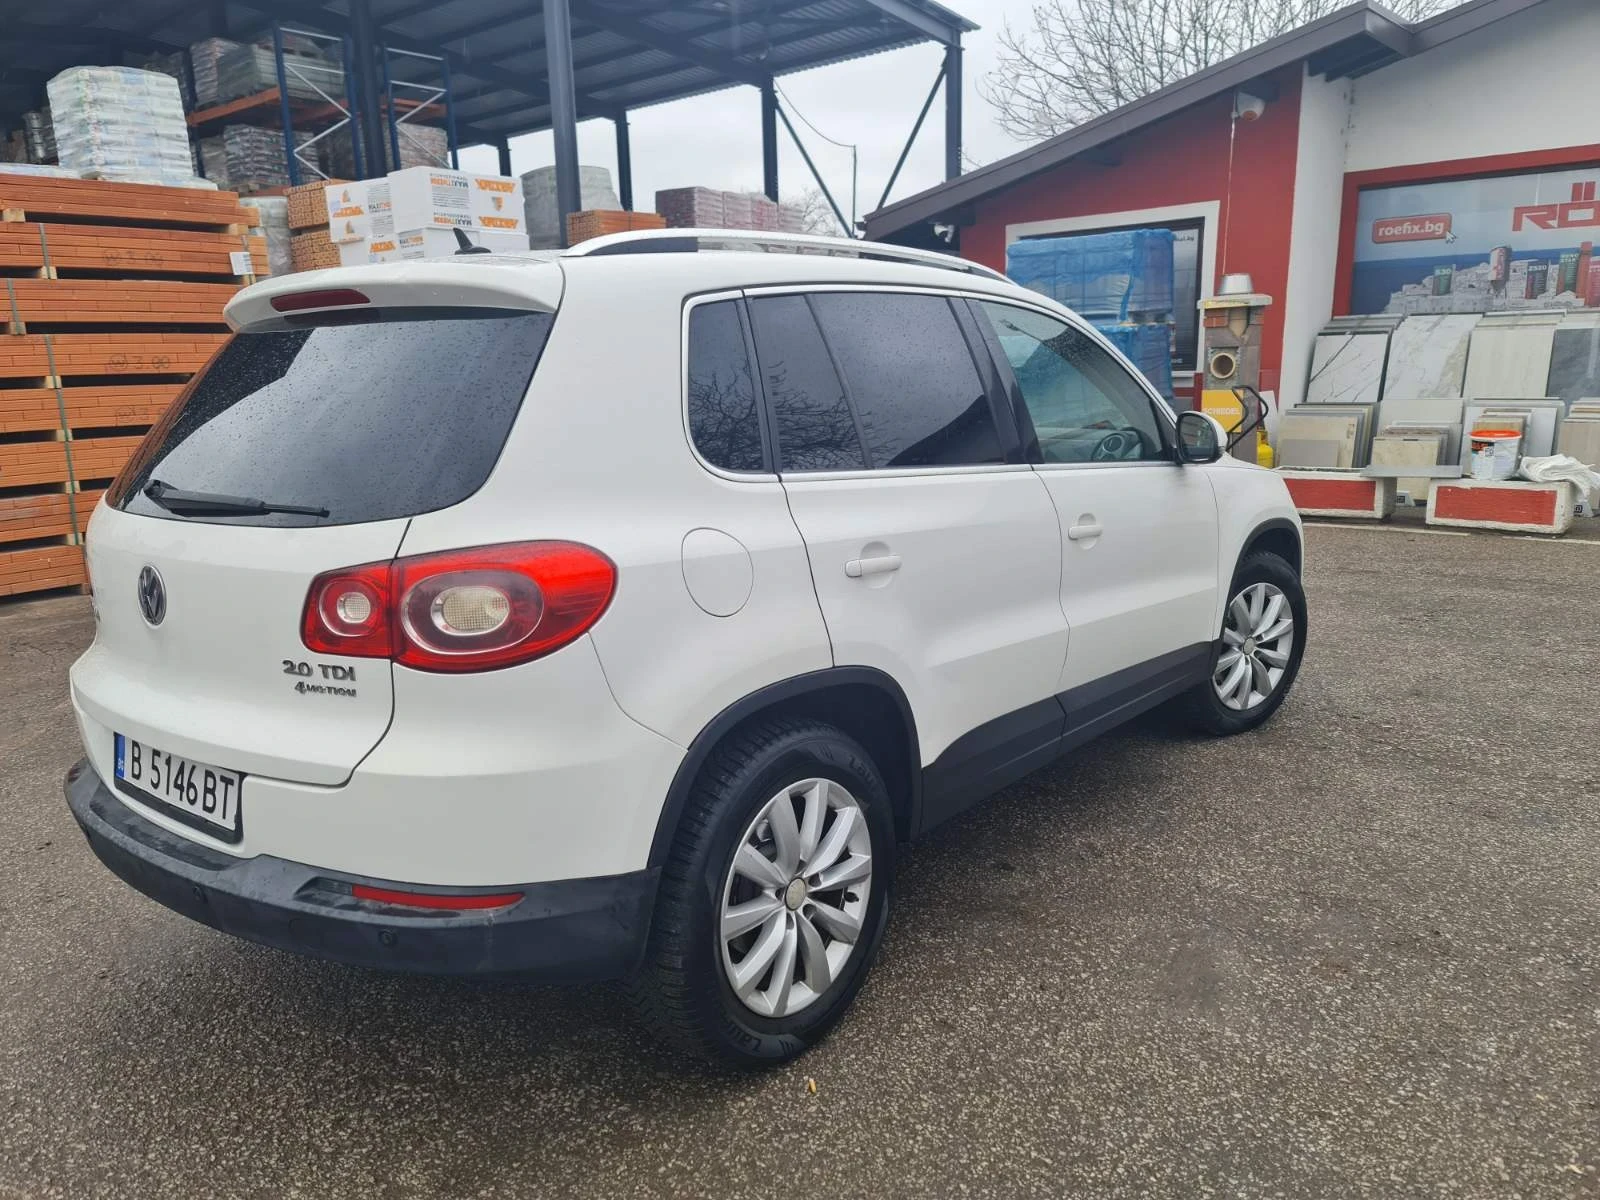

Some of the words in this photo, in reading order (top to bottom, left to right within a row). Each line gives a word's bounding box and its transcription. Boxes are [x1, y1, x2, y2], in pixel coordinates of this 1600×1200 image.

[1378, 221, 1445, 236] roefix.bg
[318, 664, 357, 681] TDI
[131, 740, 142, 780] B
